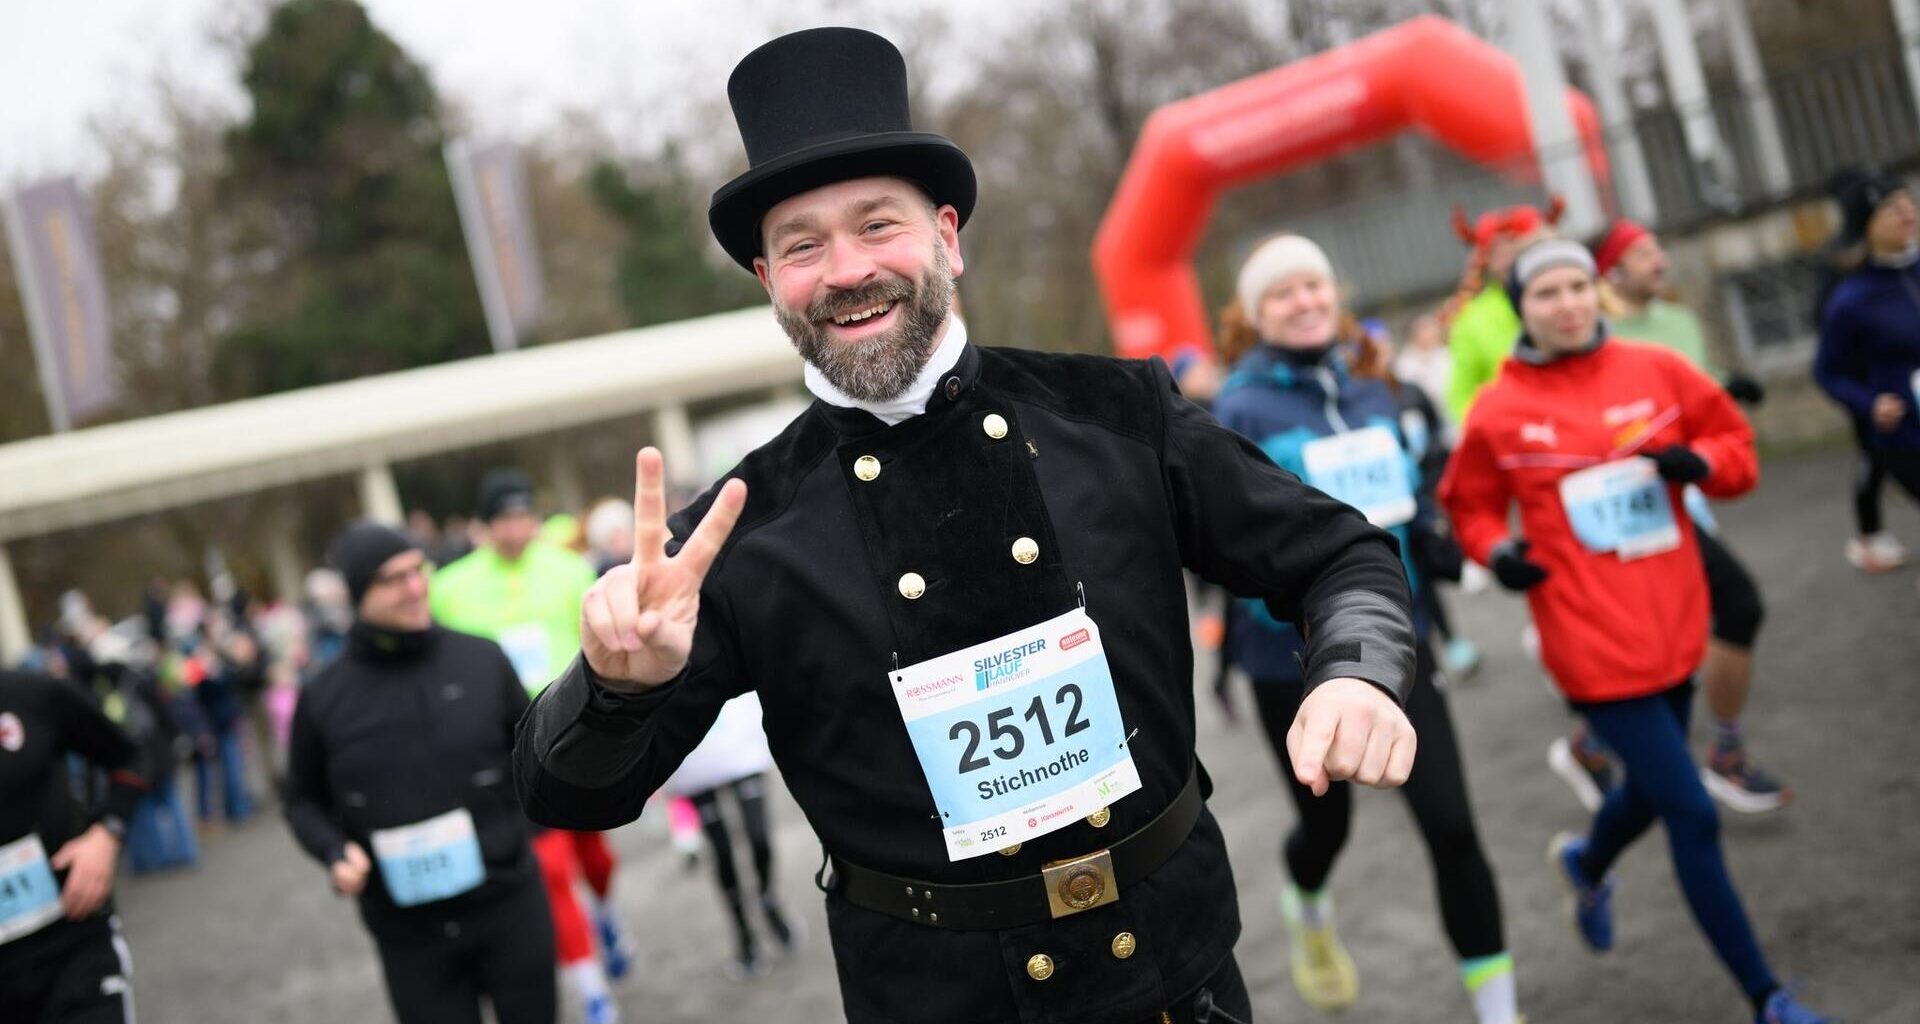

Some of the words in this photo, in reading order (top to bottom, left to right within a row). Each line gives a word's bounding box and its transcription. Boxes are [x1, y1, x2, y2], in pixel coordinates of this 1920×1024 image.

[974, 639, 1046, 672] SILVESTER
[989, 661, 1023, 681] LAUF
[990, 669, 1031, 688] HANNOVER
[906, 674, 964, 698] ROSSMANN
[949, 683, 1090, 774] 2512
[977, 749, 1090, 800] Stichnothe
[980, 825, 1008, 842] 2512
